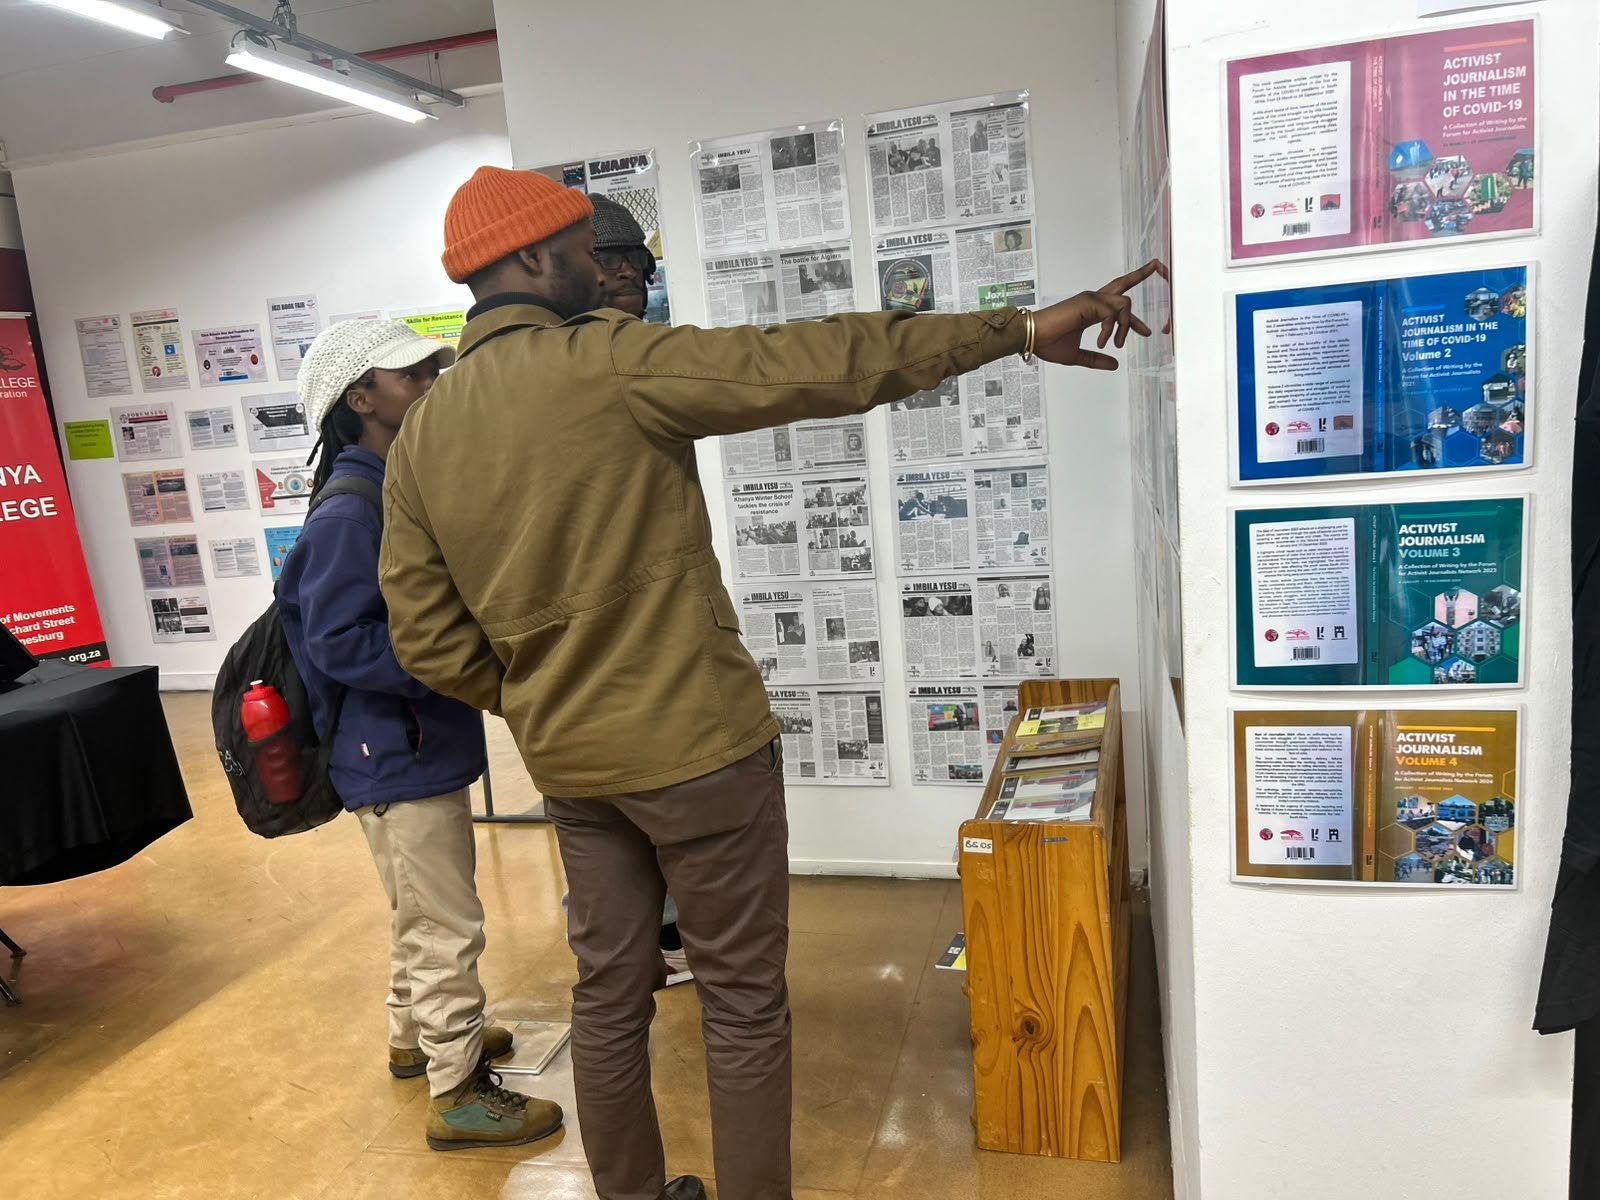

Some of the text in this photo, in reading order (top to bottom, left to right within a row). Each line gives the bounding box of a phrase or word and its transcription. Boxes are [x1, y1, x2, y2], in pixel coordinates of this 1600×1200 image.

[1443, 52, 1502, 70] ACTIVIST
[1443, 65, 1527, 86] JOURNALISM
[1443, 82, 1521, 102] IN THE TIME
[1442, 98, 1523, 118] OF COVID-19
[1448, 122, 1477, 130] Collection
[588, 154, 648, 175] KHANYA
[885, 233, 933, 248] IMBILA YESU
[715, 257, 758, 270] IMBILA YESU
[792, 256, 809, 264] battle
[820, 253, 841, 261] Algiers
[980, 295, 1005, 305] Book
[985, 290, 1005, 299] Jozi
[1402, 314, 1445, 326] ACTIVIST
[1402, 321, 1499, 338] JOURNALISM IN THE
[1402, 333, 1487, 349] TIME OF COVID-19
[1402, 348, 1452, 362] Volume 2
[1407, 365, 1434, 373] Collection
[0, 377, 37, 389] LEGE
[906, 471, 950, 482] IMBILA YESU
[742, 481, 779, 491] IMBILA YESU
[0, 496, 58, 522] EGE
[1399, 522, 1458, 535] ACTIVIST
[1398, 533, 1485, 547] JOURNALISM
[1399, 547, 1461, 558] VOLUME 3
[939, 582, 957, 590] YESU
[751, 591, 789, 601] IMBILA YESU
[13, 604, 76, 622] Movements
[42, 616, 76, 629] Street
[779, 690, 797, 698] YESU
[918, 686, 961, 695] IMBILA YESU
[1396, 732, 1456, 743] ACTIVIST
[1395, 744, 1483, 756] JOURNALISM
[1395, 756, 1458, 766] VOLUME 4
